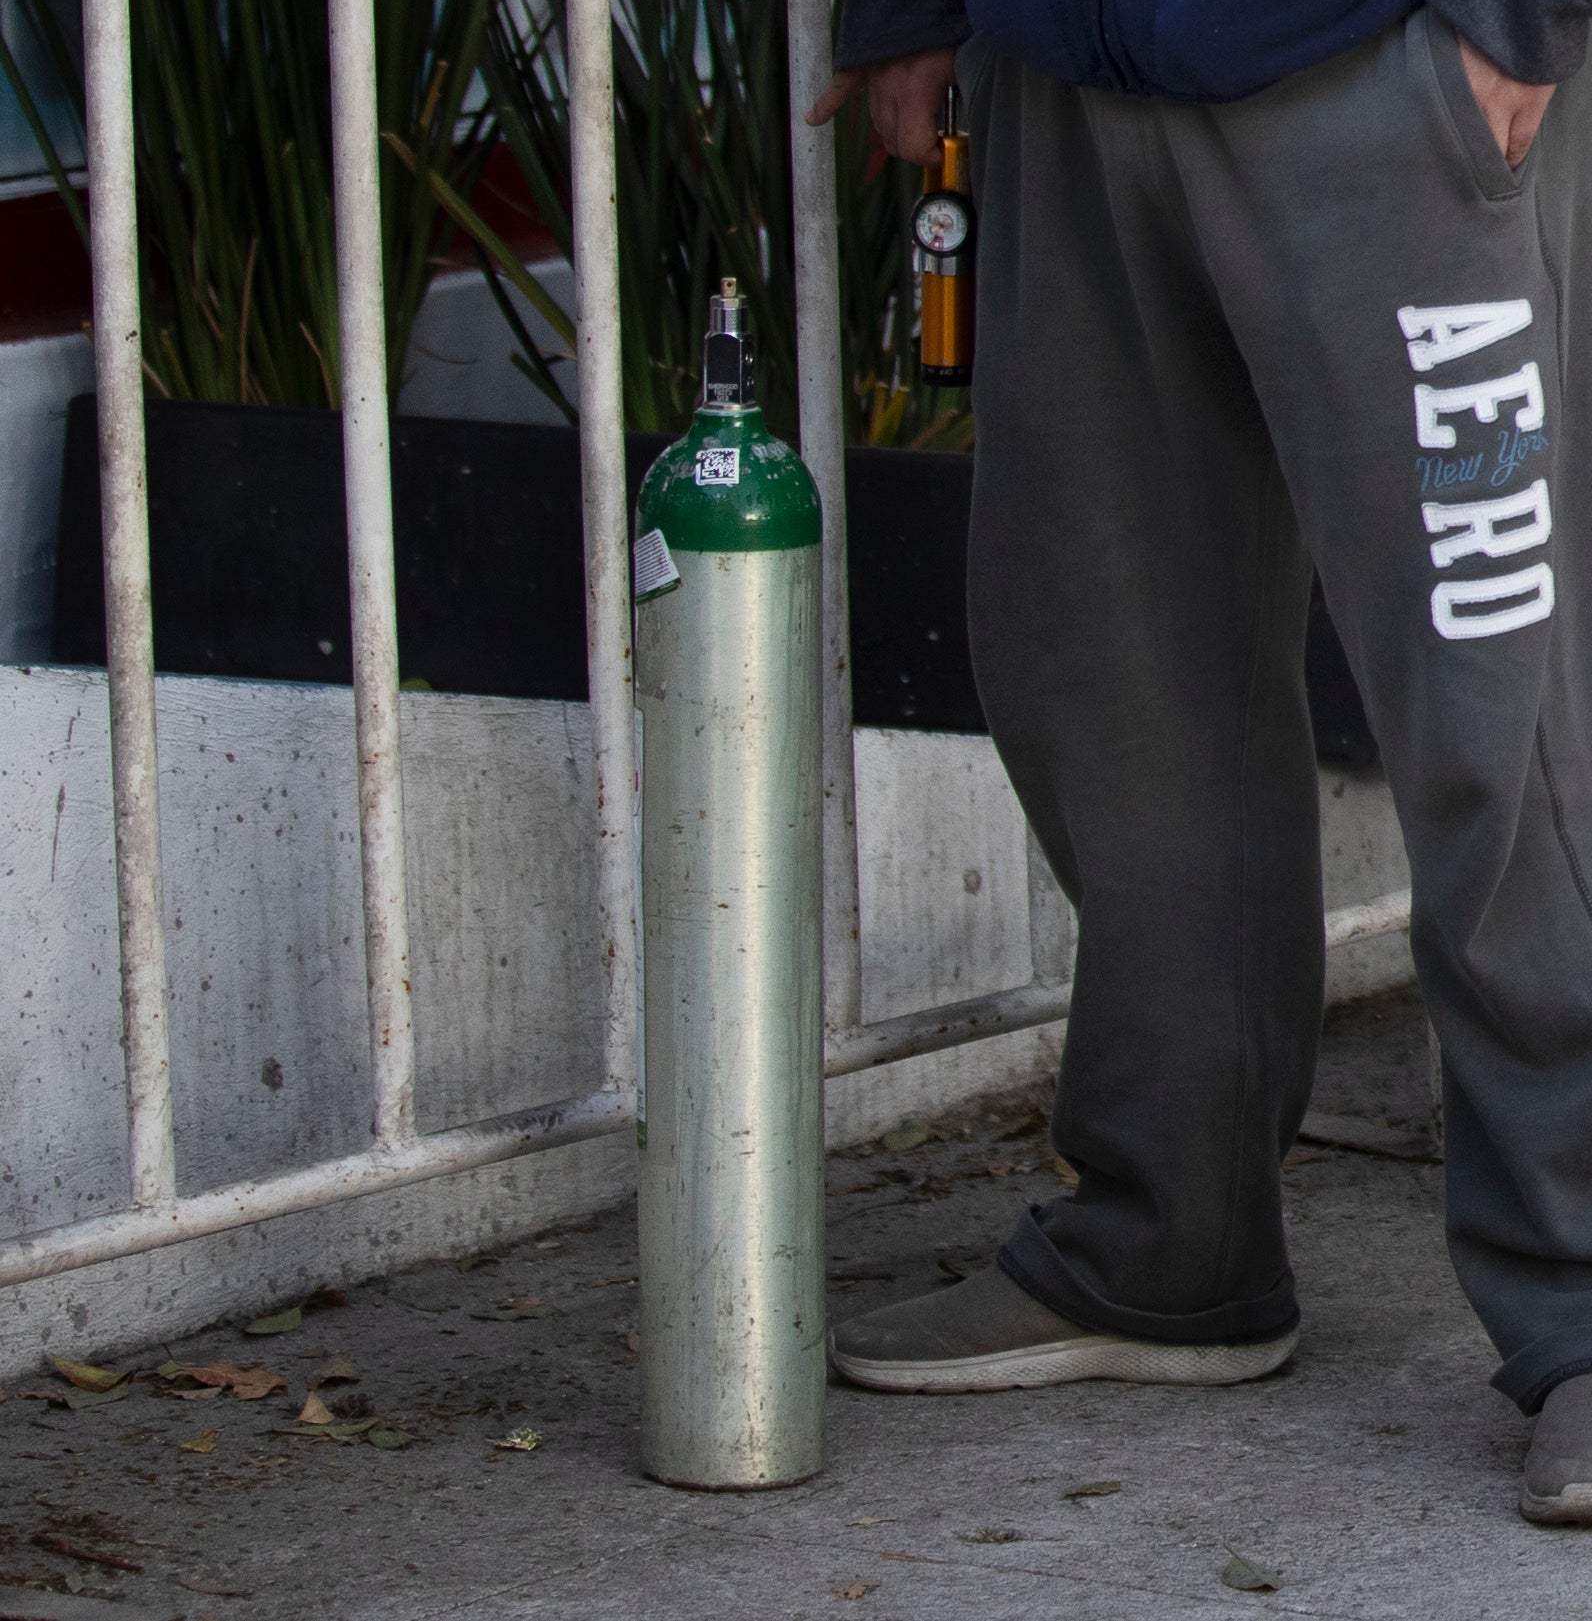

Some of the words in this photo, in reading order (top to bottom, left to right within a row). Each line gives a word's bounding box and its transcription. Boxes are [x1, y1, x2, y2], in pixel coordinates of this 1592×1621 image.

[1396, 298, 1556, 641] AERO
[1414, 451, 1484, 493] New
[1490, 424, 1550, 487] York
